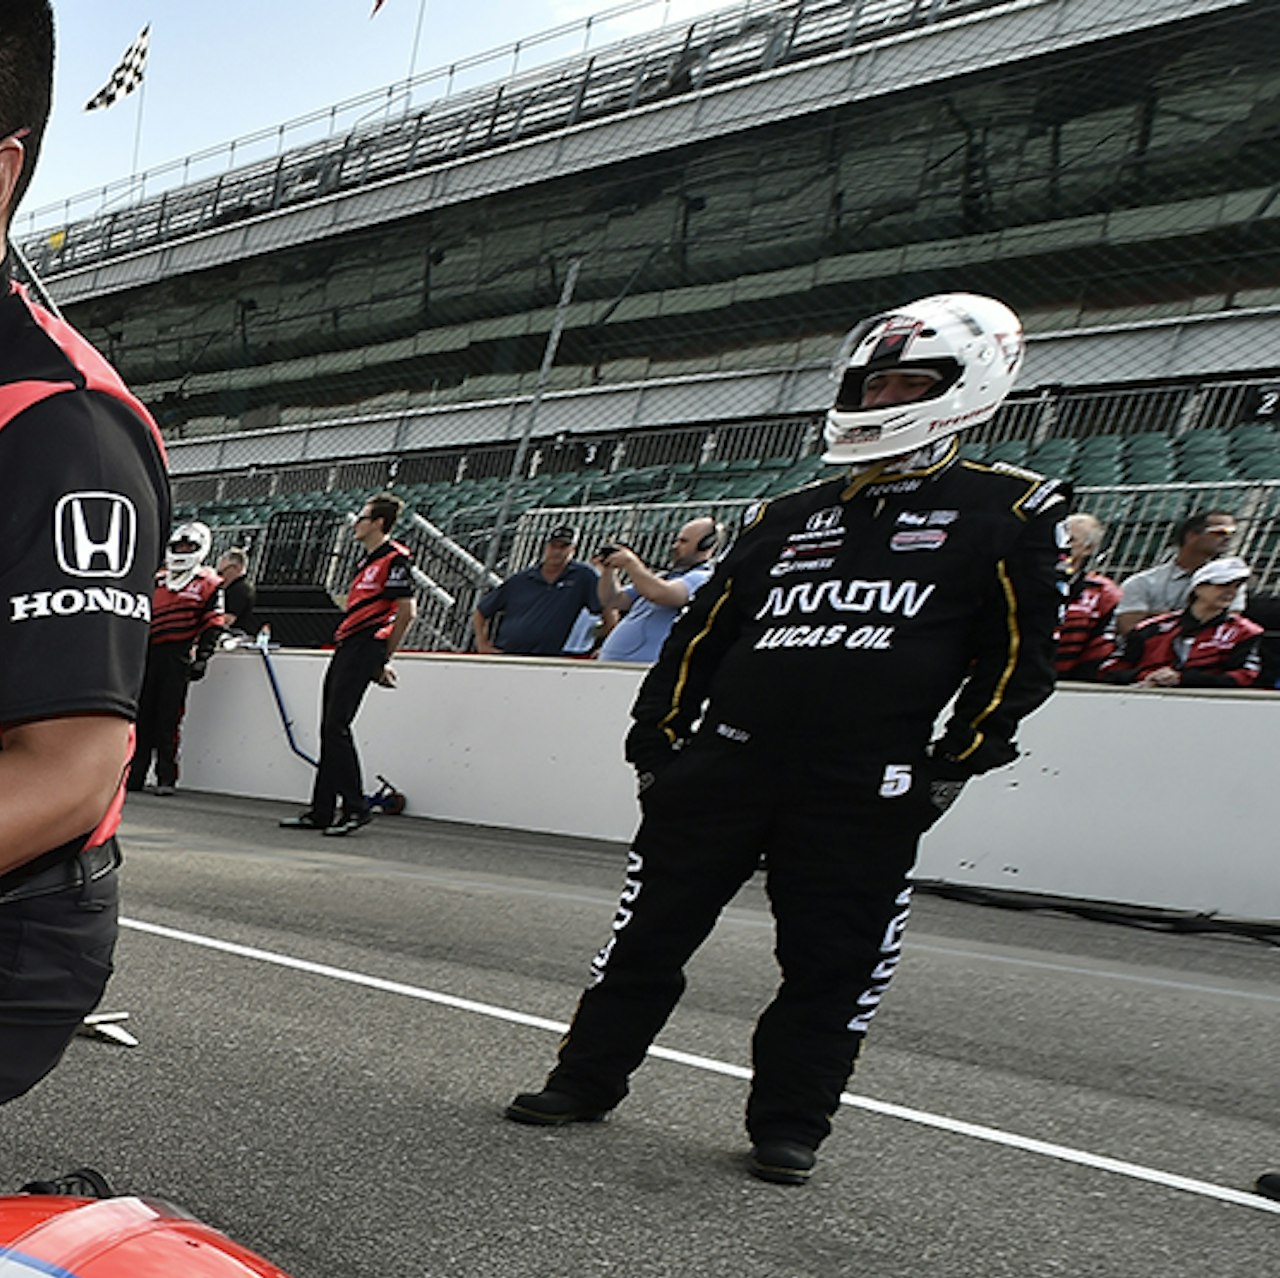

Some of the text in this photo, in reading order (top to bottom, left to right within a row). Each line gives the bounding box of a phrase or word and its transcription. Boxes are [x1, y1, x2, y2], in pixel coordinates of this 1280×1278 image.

[10, 587, 151, 622] HONDA
[754, 580, 936, 620] ARROW
[753, 624, 895, 650] LUCAS OIL
[879, 764, 913, 798] 5
